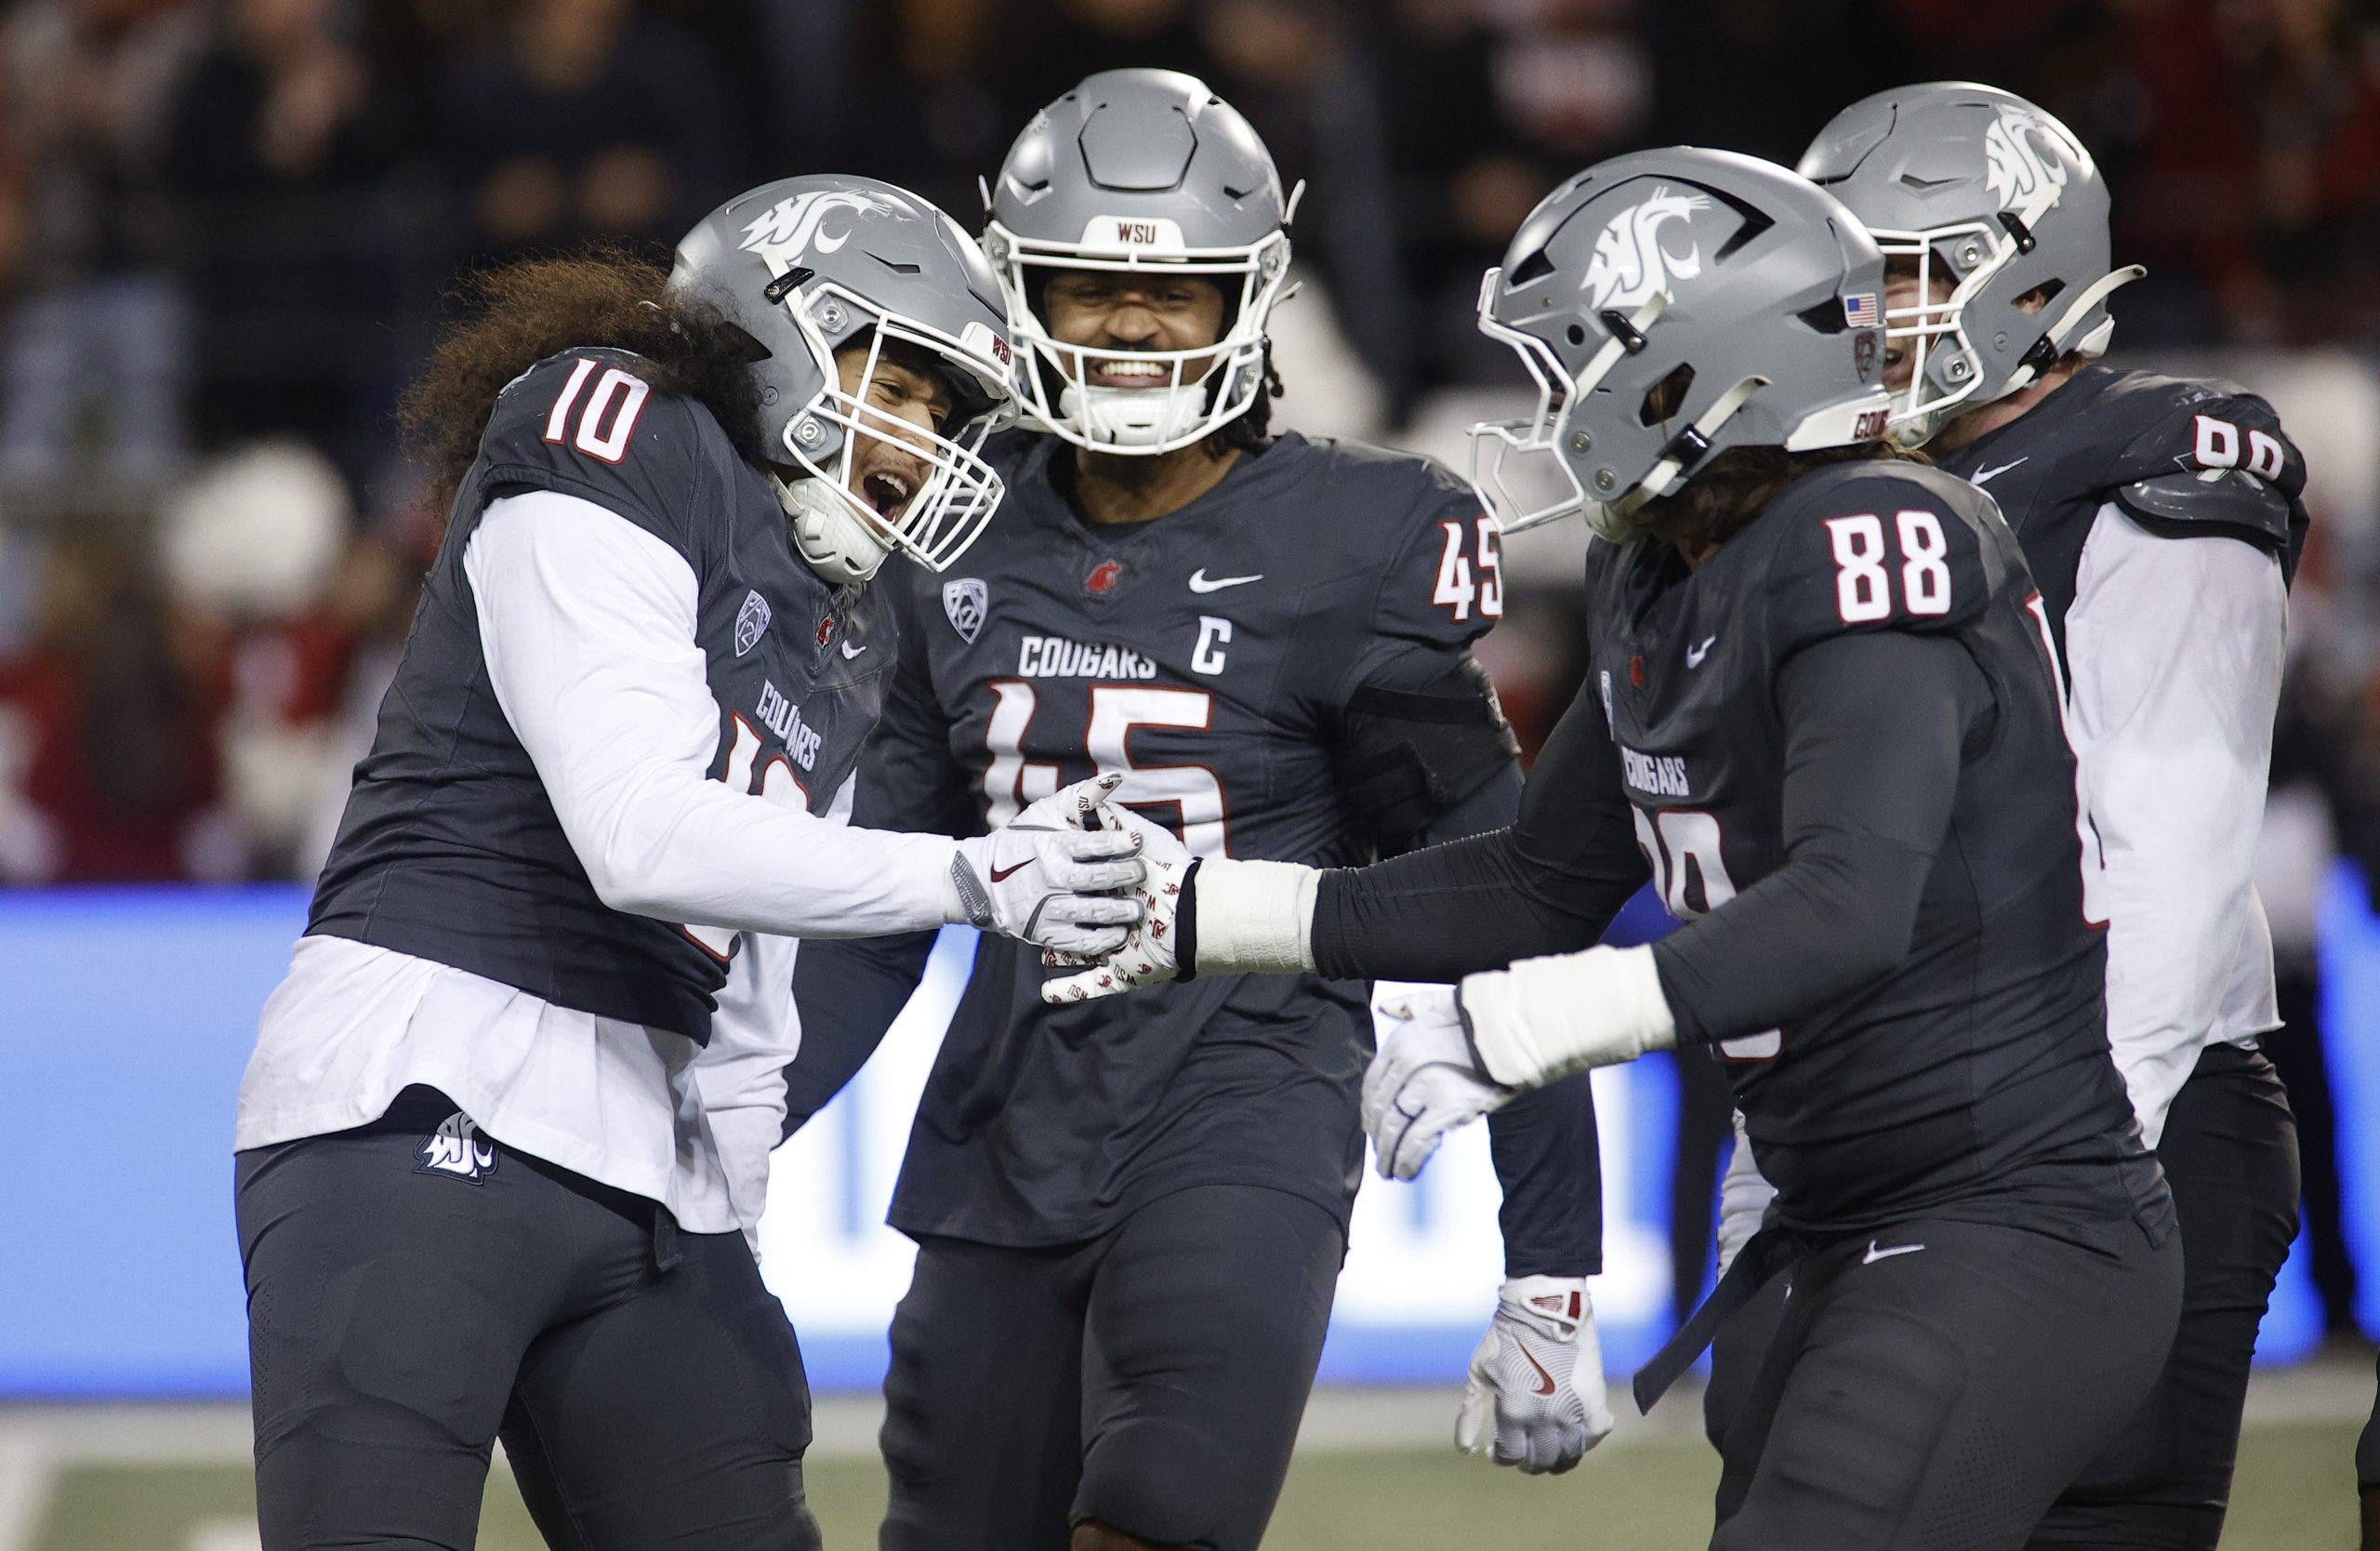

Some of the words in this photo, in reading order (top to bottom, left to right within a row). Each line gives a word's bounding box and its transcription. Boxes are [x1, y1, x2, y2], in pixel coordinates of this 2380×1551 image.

[1117, 222, 1157, 245] WSU
[543, 357, 651, 465] 10
[1430, 515, 1503, 623] 45
[1820, 510, 1951, 626] 88
[1018, 636, 1157, 679] COUGARS
[1190, 616, 1232, 675] C
[1135, 887, 1156, 911] WSU
